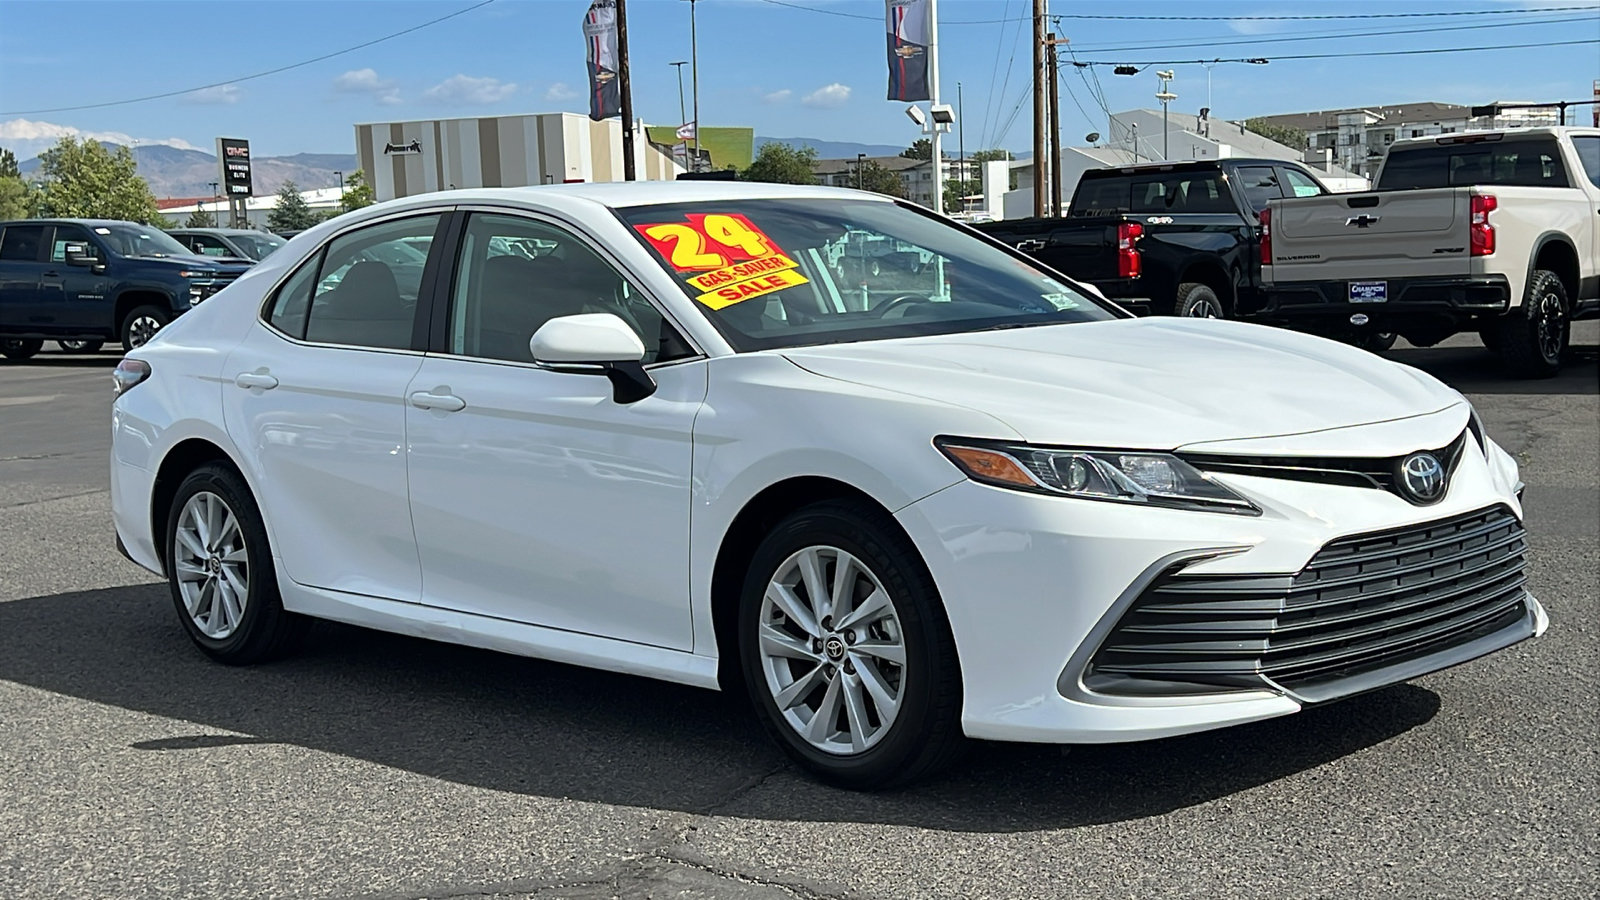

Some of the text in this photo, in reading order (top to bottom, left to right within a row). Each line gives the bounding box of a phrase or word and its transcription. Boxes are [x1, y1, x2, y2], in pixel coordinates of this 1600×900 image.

[226, 147, 248, 156] GMC
[645, 214, 776, 269] 24
[696, 257, 786, 288] GAS-SAVER
[717, 275, 788, 301] SALE
